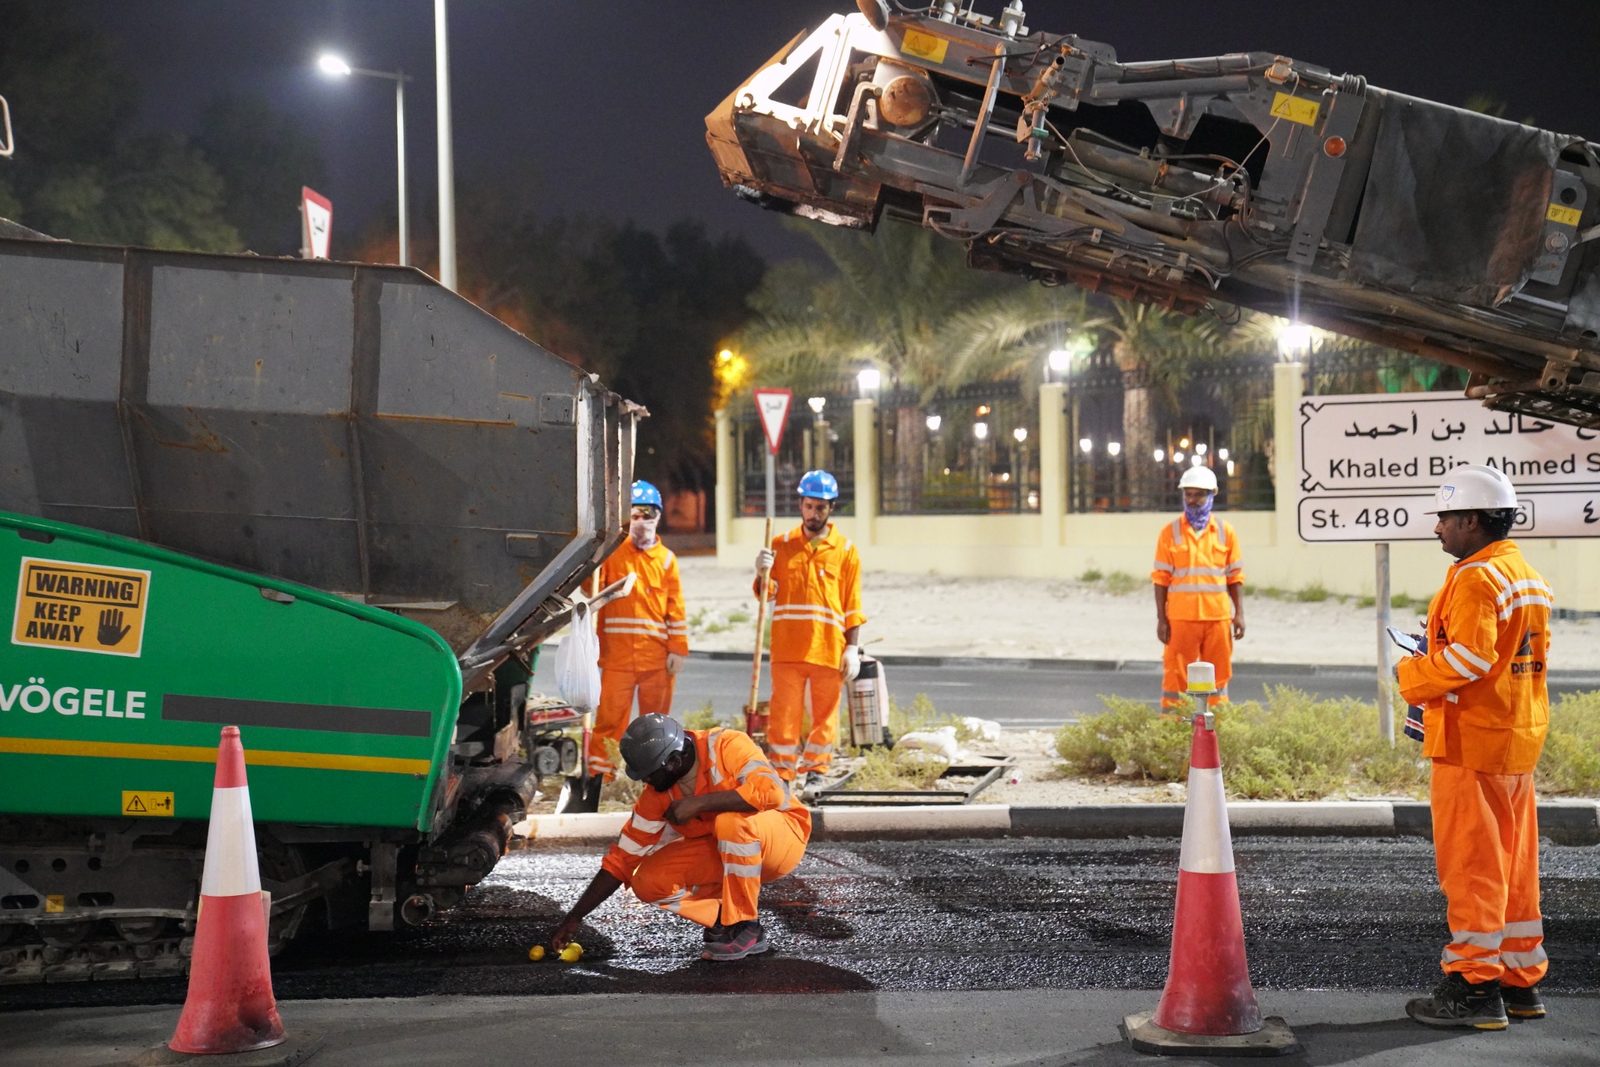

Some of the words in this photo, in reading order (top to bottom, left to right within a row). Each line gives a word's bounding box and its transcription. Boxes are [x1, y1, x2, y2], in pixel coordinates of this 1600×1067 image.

[1344, 409, 1418, 439] أحمد
[1431, 418, 1466, 441] بن
[1330, 457, 1418, 478] Khaled
[1311, 508, 1346, 529] St.
[1355, 507, 1409, 528] 480
[36, 572, 134, 601] WARNING
[34, 601, 81, 622] KEEP
[25, 620, 85, 643] AWAY
[0, 676, 147, 719] VÖGELE
